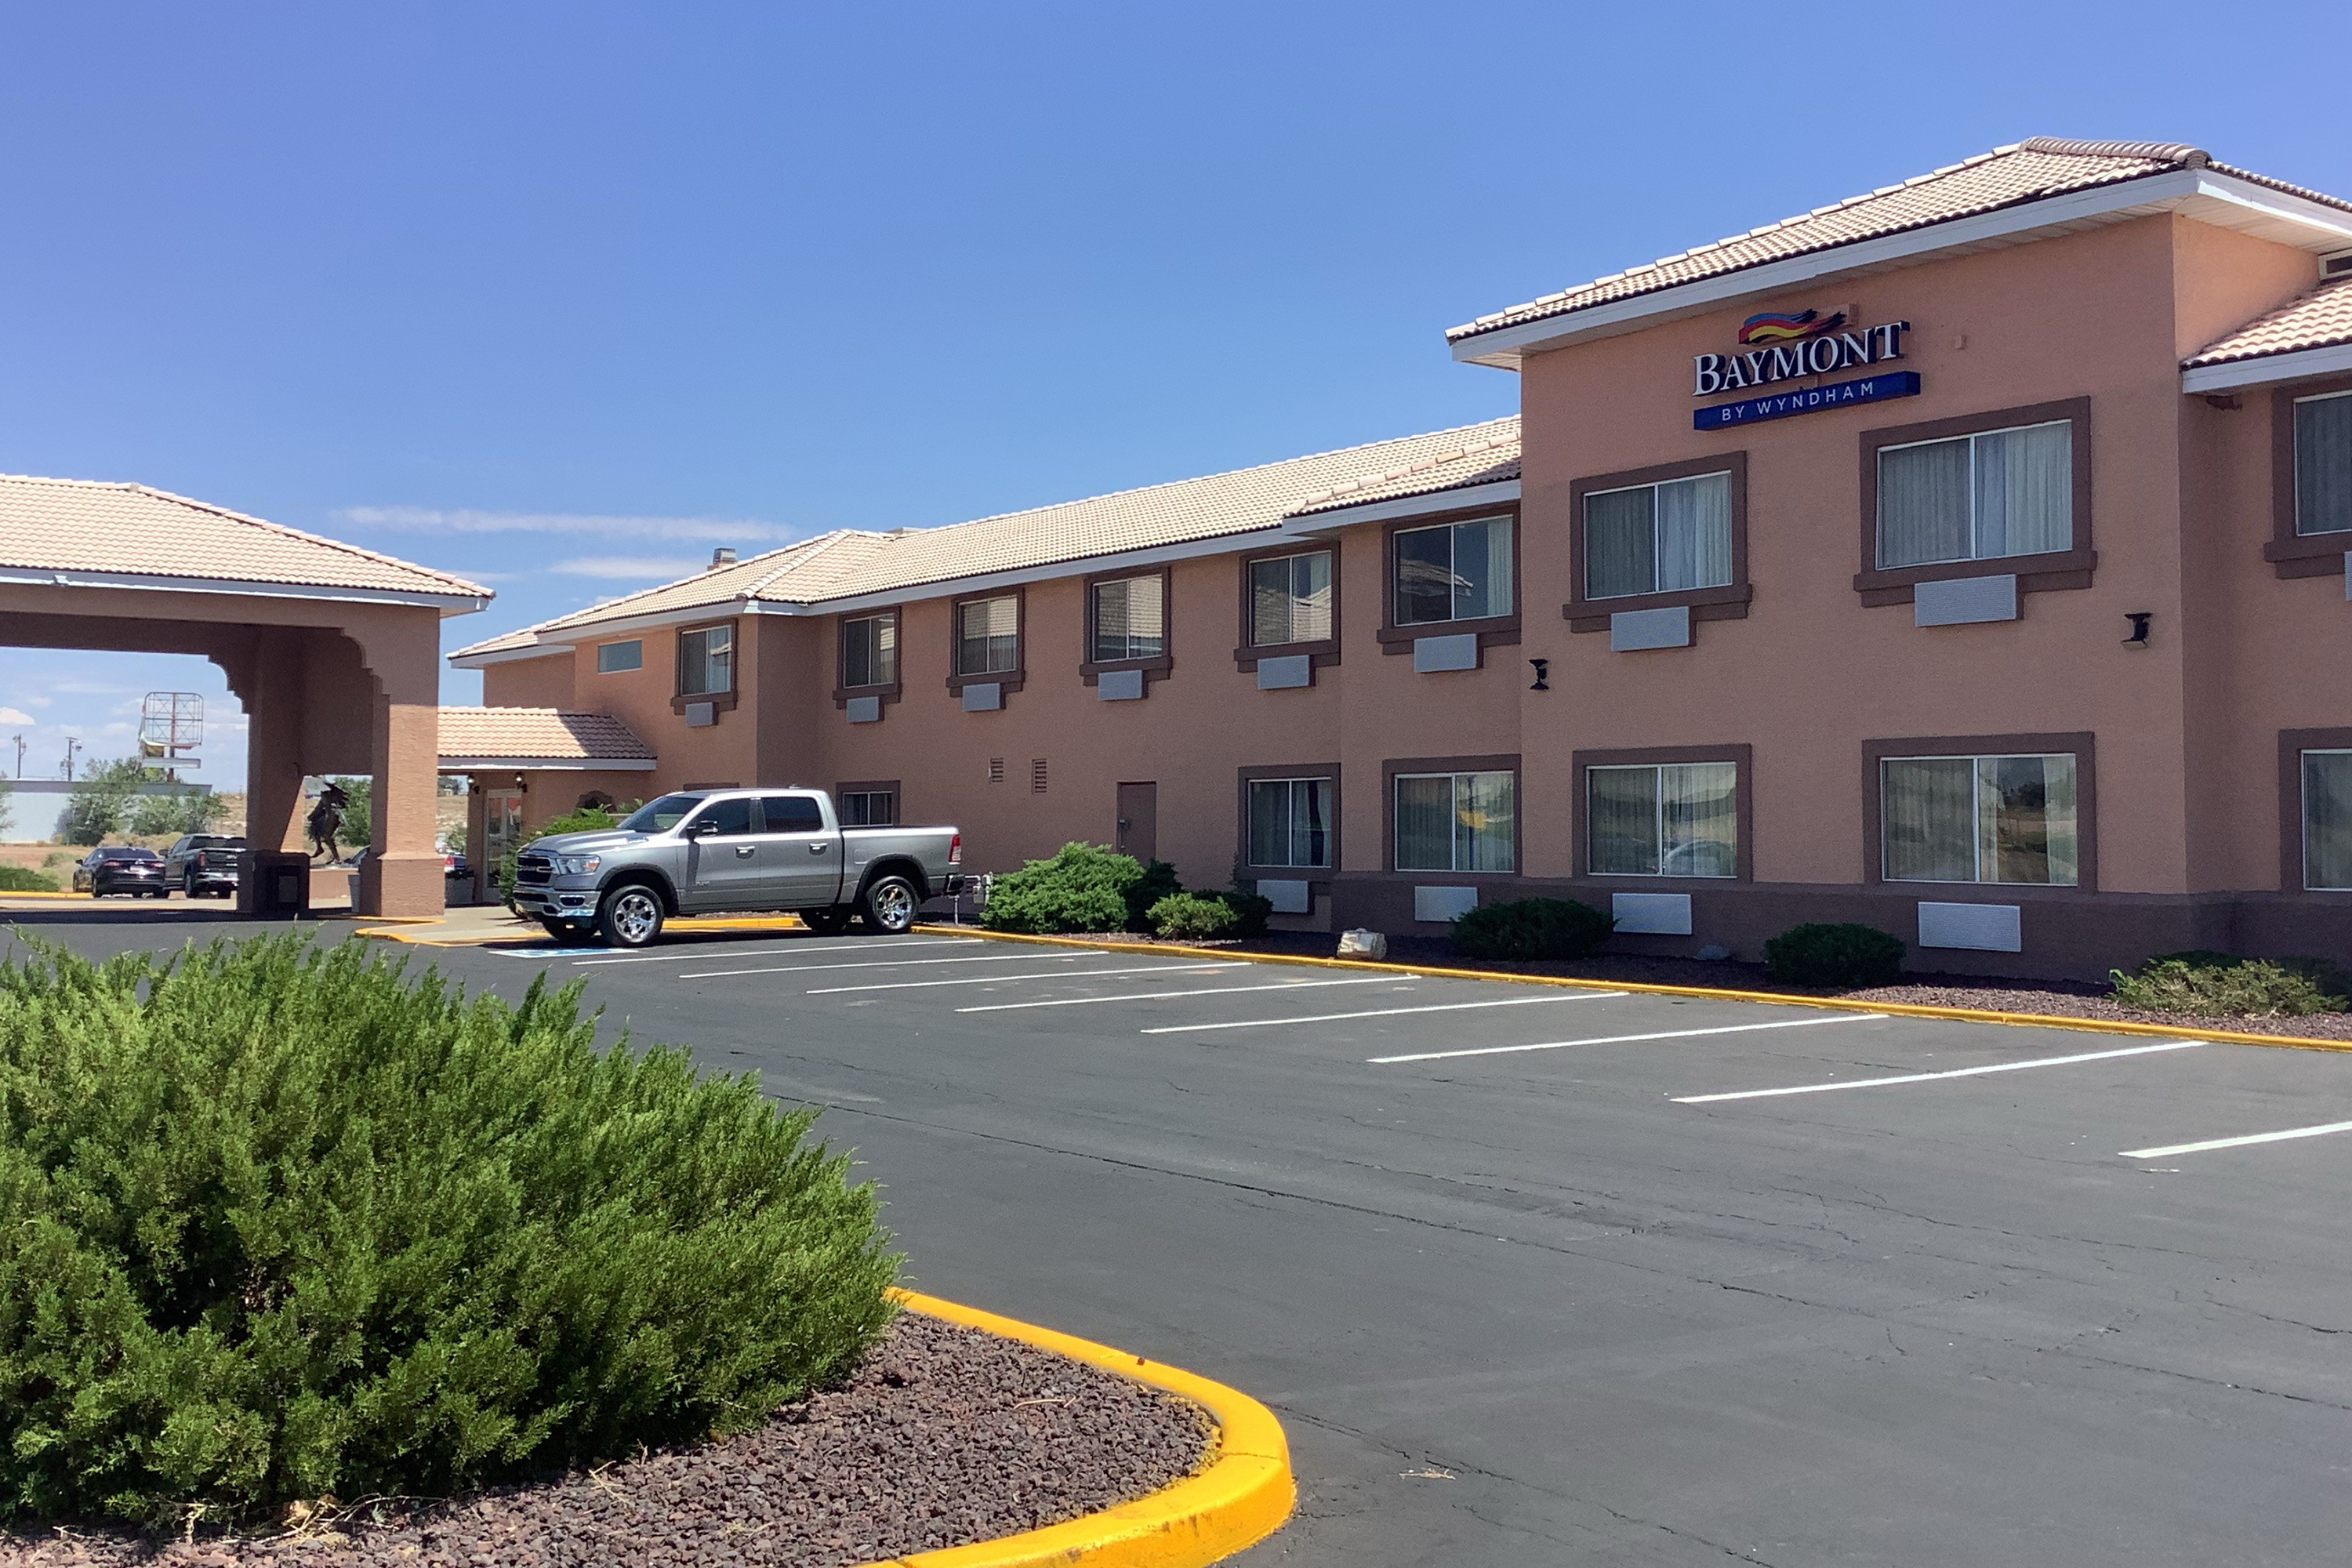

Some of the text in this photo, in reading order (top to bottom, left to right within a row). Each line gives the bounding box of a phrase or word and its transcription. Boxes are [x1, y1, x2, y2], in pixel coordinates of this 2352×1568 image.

[1693, 321, 1909, 396] BAYMONT
[1722, 382, 1873, 421] BY WYNDHAM
